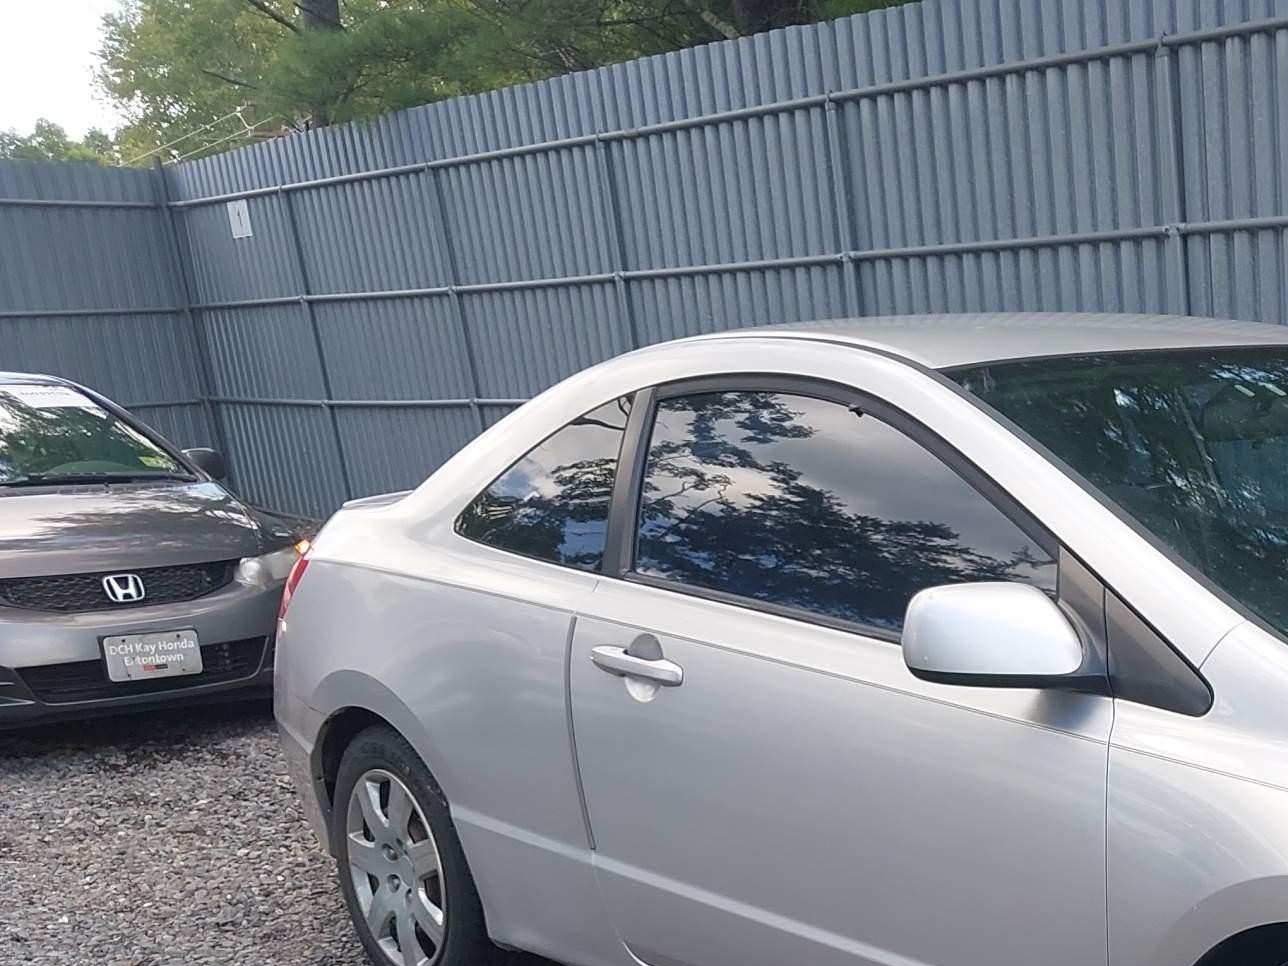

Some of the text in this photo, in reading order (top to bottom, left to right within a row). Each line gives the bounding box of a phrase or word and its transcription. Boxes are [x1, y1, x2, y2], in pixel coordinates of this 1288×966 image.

[109, 638, 194, 655] DCH Kay Honda
